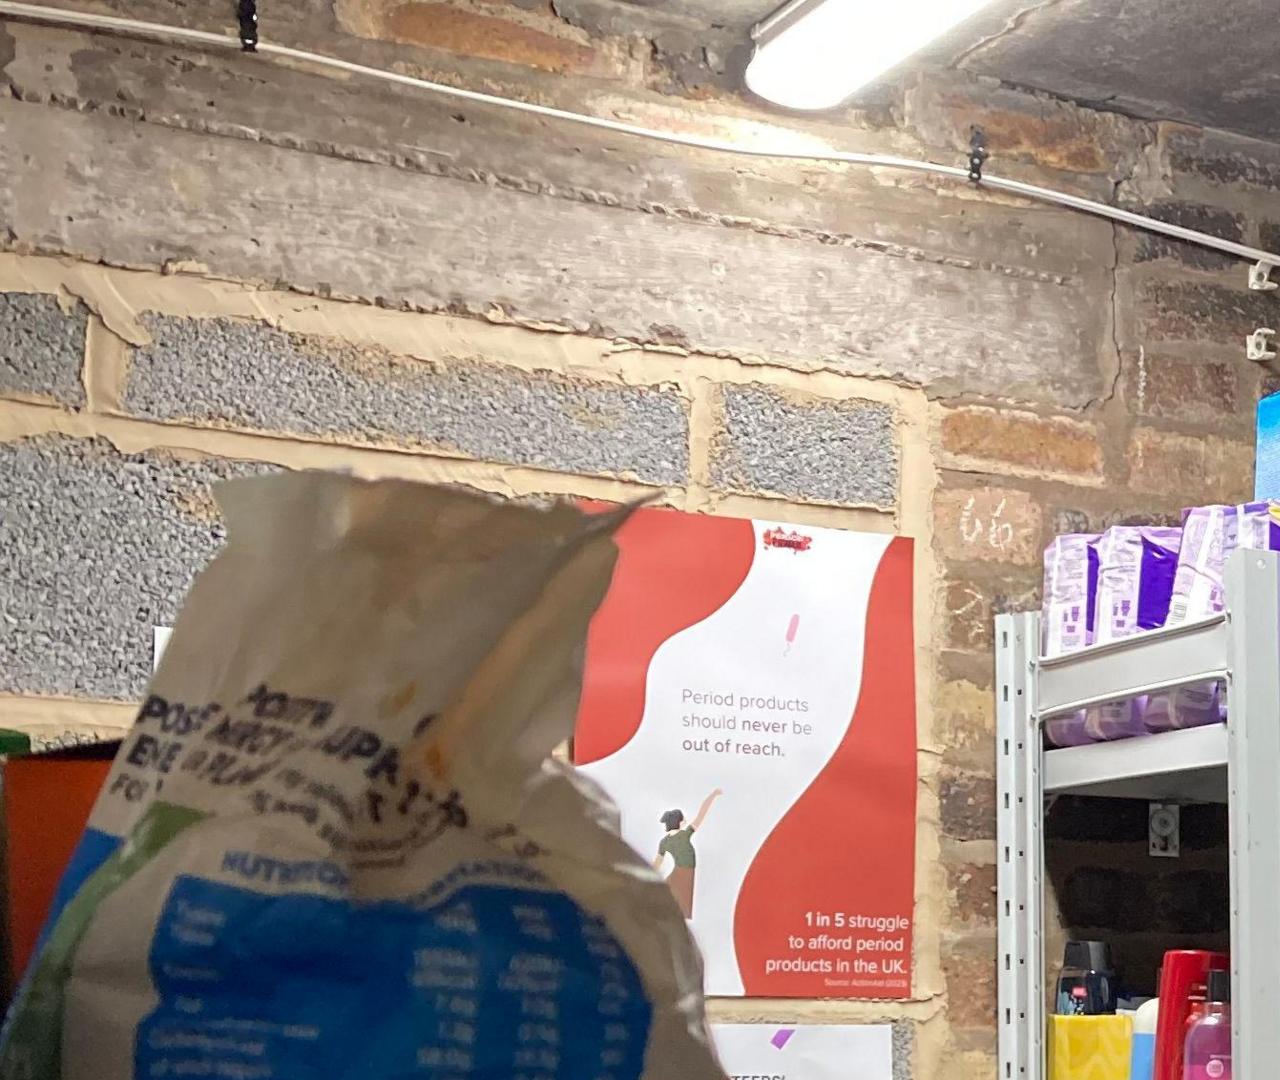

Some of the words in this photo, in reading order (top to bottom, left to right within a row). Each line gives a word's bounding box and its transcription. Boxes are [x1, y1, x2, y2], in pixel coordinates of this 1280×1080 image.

[682, 688, 734, 707] Period
[739, 691, 810, 713] products
[682, 713, 737, 732] should
[742, 720, 787, 734] never
[792, 718, 813, 735] be
[682, 738, 710, 752] out
[714, 738, 732, 754] of
[735, 741, 786, 758] reach.
[805, 912, 813, 927] 1
[816, 912, 830, 927] in
[835, 913, 845, 928] 5
[849, 915, 910, 933] struggle
[788, 935, 805, 949] to
[808, 935, 852, 950] afford
[856, 937, 904, 953] period
[765, 957, 833, 975] products
[836, 957, 850, 973] in
[854, 958, 878, 973] the
[882, 959, 908, 974] UK.
